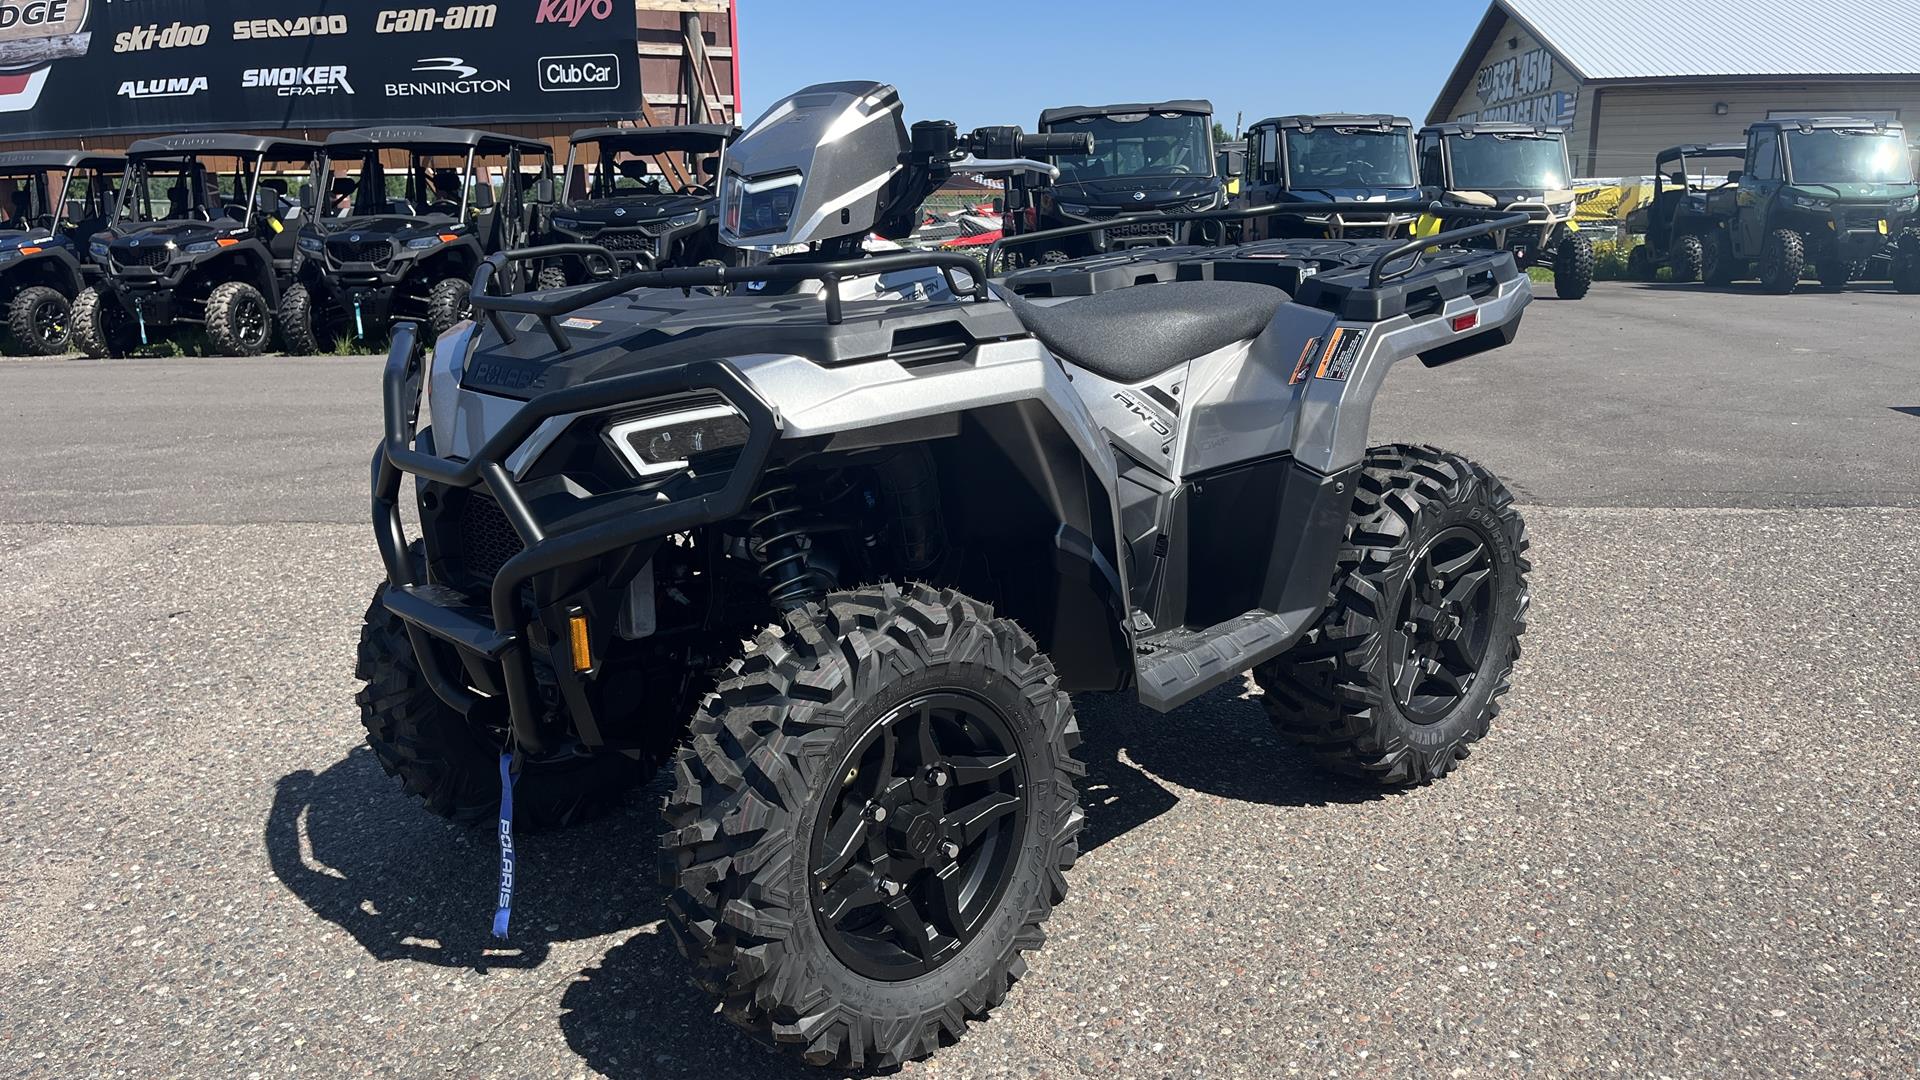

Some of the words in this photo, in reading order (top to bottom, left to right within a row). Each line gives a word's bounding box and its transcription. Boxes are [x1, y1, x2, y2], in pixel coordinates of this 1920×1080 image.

[376, 5, 497, 33] can-am
[114, 22, 210, 52] ski-doo
[242, 65, 354, 94] SMOKER
[547, 64, 581, 83] Club
[582, 62, 611, 82] Car
[117, 77, 208, 98] ALUMA
[277, 86, 339, 96] CRAFT
[385, 79, 511, 96] BENNINGTON
[475, 362, 549, 390] POLARIS
[1112, 393, 1169, 435] AWD
[500, 818, 512, 909] POLARIS
